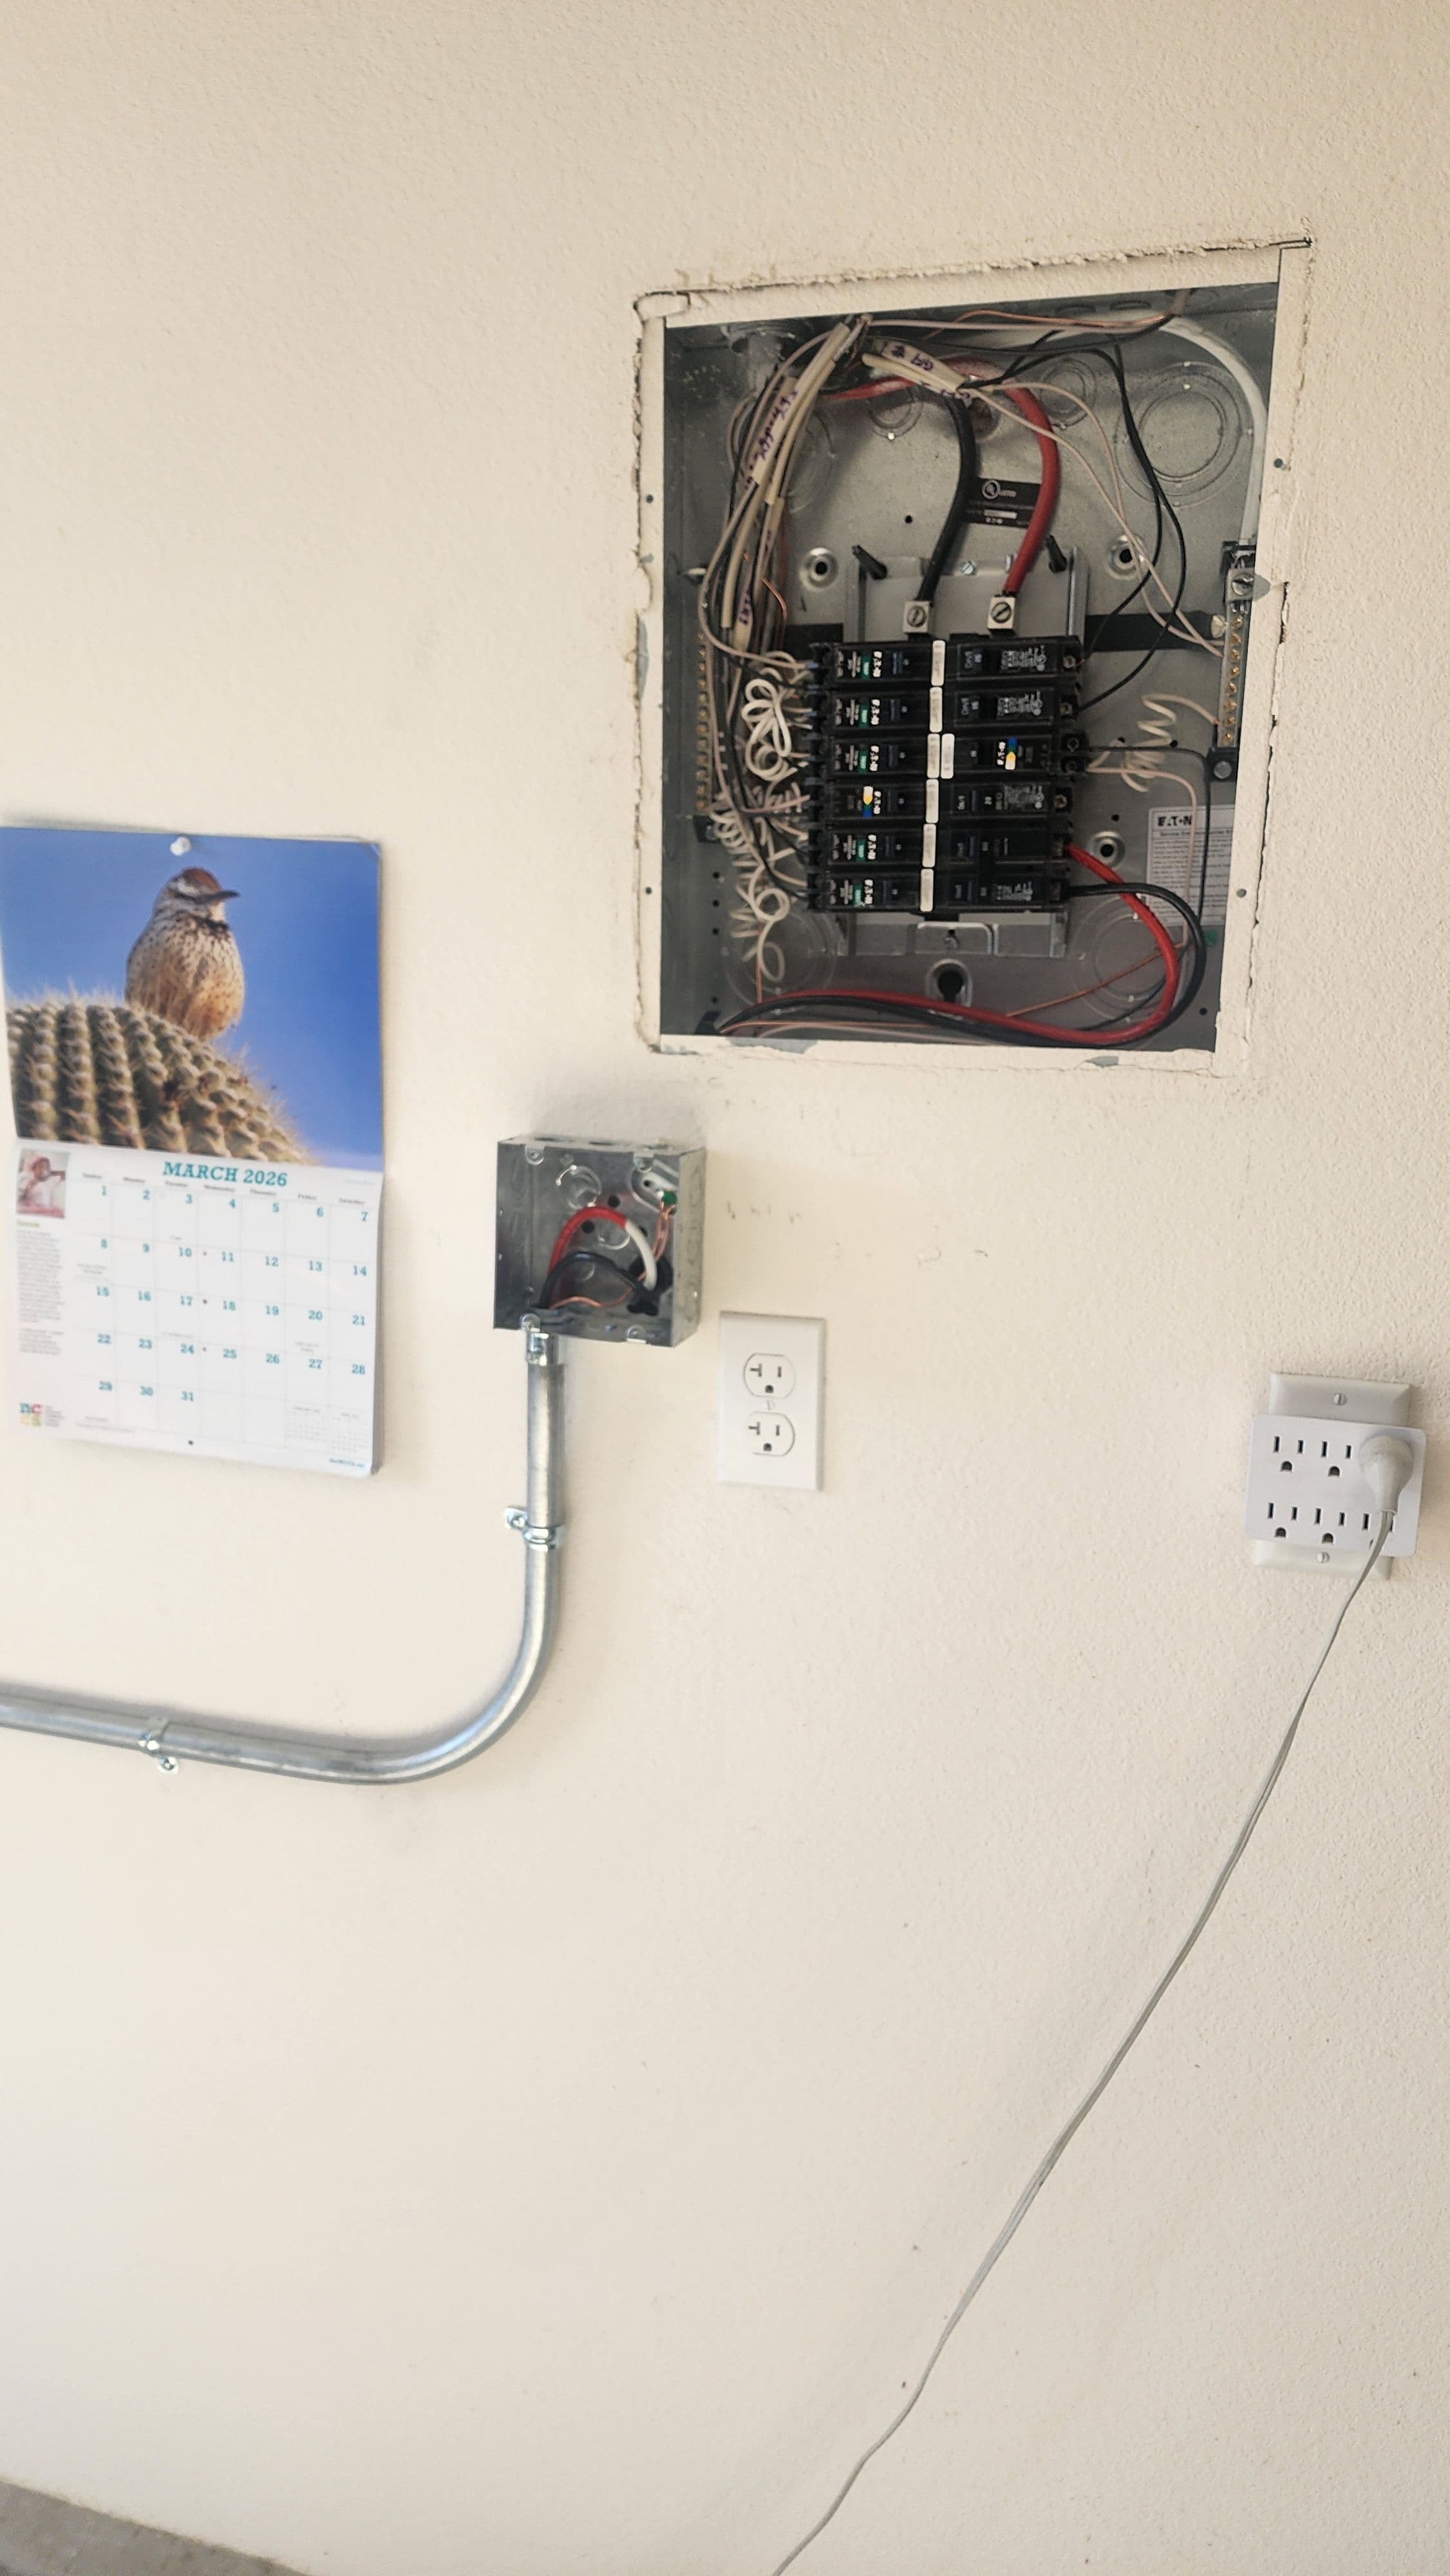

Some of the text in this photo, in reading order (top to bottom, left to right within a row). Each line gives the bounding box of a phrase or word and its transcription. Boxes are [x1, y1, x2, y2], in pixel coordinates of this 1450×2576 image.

[163, 1161, 287, 1188] MARCH 2026
[102, 1186, 368, 1221] 1 2 3 4 5 6 7
[143, 1244, 149, 1253] 9
[179, 1247, 192, 1257] 10
[221, 1252, 234, 1262] 11
[265, 1257, 278, 1267] 12
[309, 1261, 323, 1271] 13
[353, 1266, 367, 1277] 14
[97, 1287, 366, 1325] 15 16 17 18 19 20 21
[97, 1334, 366, 1376] 22 23 24 25 26 27 28
[182, 1391, 193, 1401] 31
